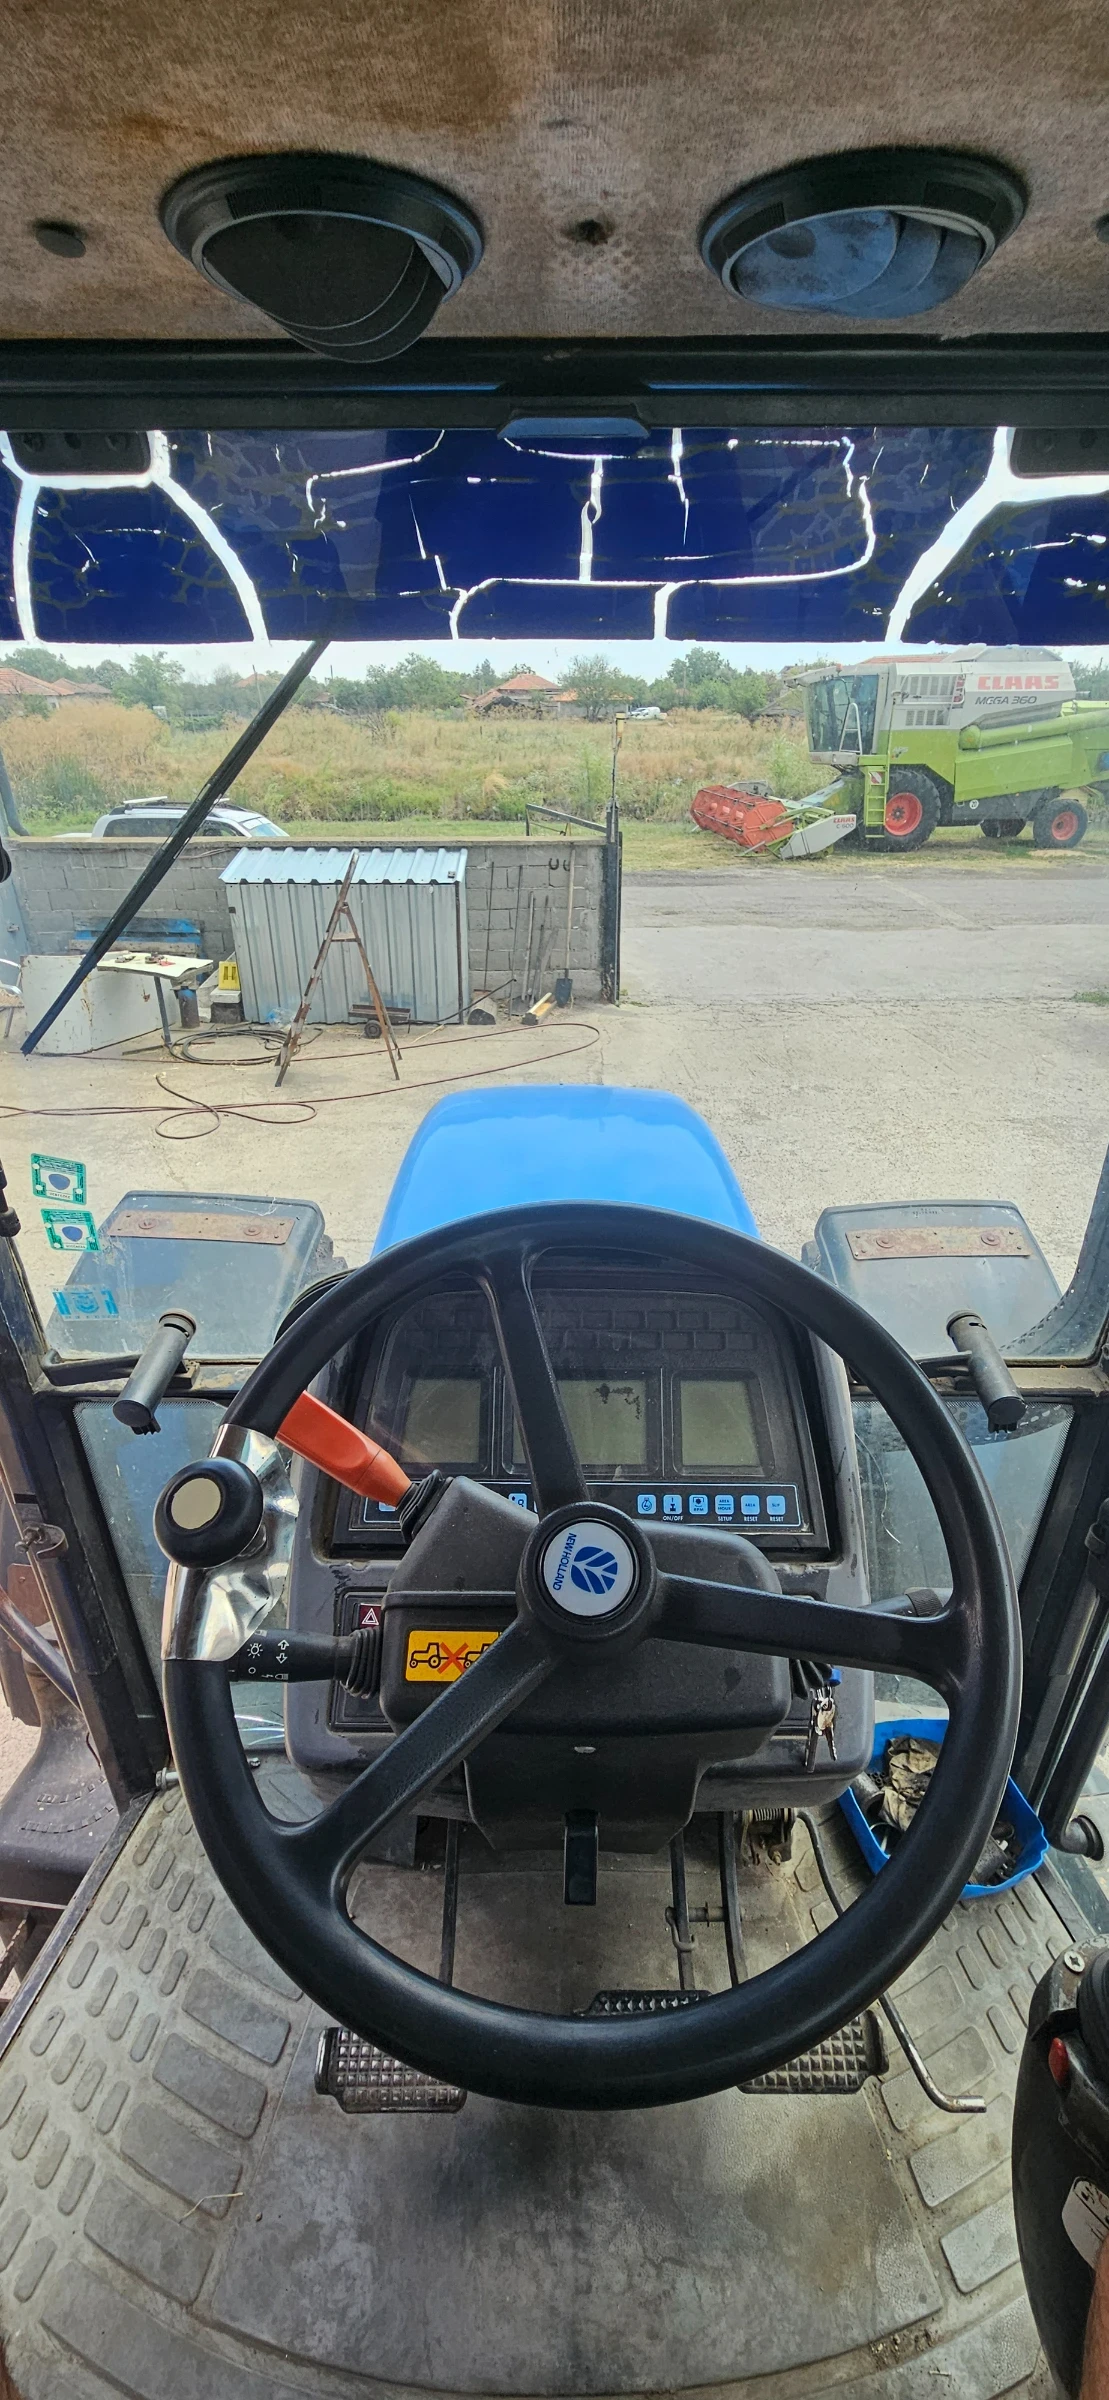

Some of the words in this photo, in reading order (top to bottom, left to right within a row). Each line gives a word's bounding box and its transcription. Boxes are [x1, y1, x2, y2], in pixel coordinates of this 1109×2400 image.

[977, 675, 1060, 690] CLAAS
[1011, 696, 1037, 705] 360
[565, 1532, 577, 1553] NEW
[553, 1551, 572, 1590] HOLLAND
